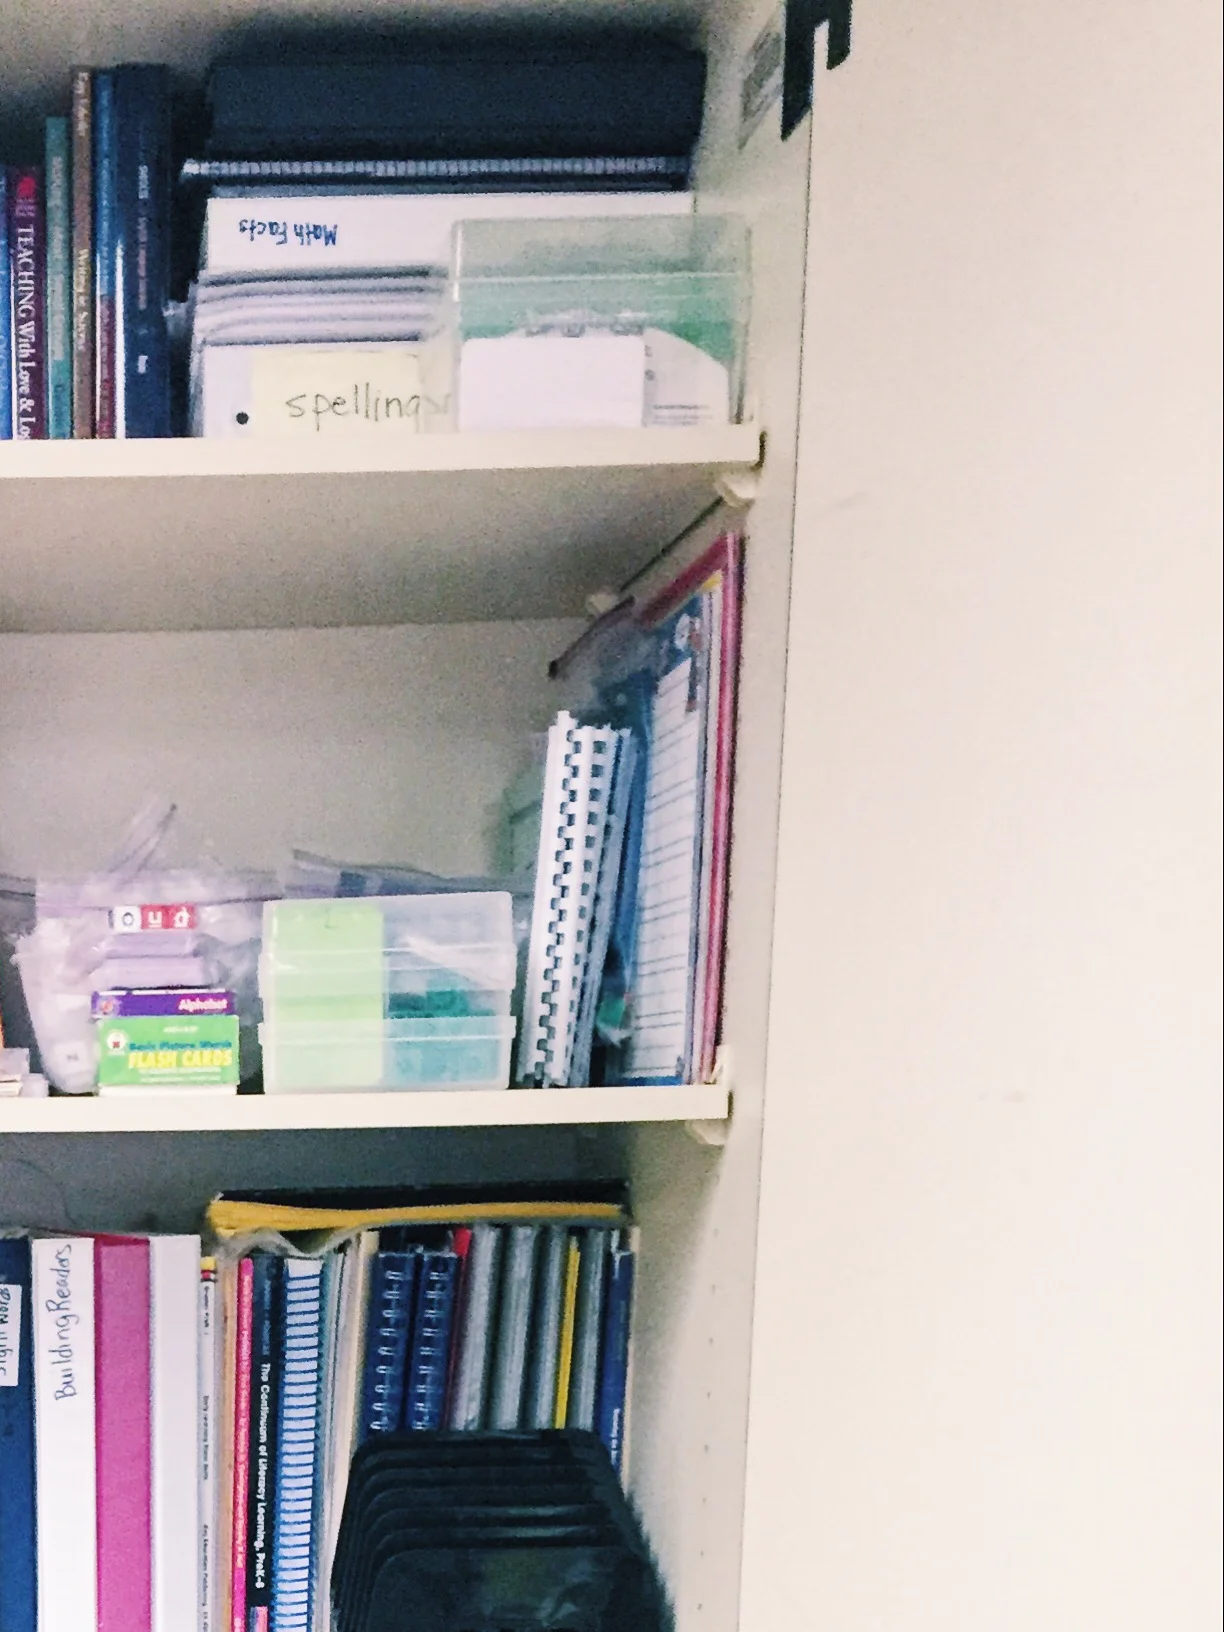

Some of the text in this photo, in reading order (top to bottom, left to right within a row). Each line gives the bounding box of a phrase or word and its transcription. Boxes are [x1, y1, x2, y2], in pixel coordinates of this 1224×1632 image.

[239, 219, 338, 246] Math Facts
[16, 225, 35, 318] TEACHING
[18, 320, 36, 358] With
[19, 361, 37, 395] Love
[285, 382, 422, 432] spelling
[178, 998, 228, 1013] Alphabet
[128, 1050, 233, 1069] FLASH CARDS
[260, 1363, 272, 1383] The
[258, 1384, 272, 1443] Continuum
[258, 1446, 270, 1457] of
[255, 1458, 269, 1501] Literacy
[254, 1502, 267, 1551] Learning,
